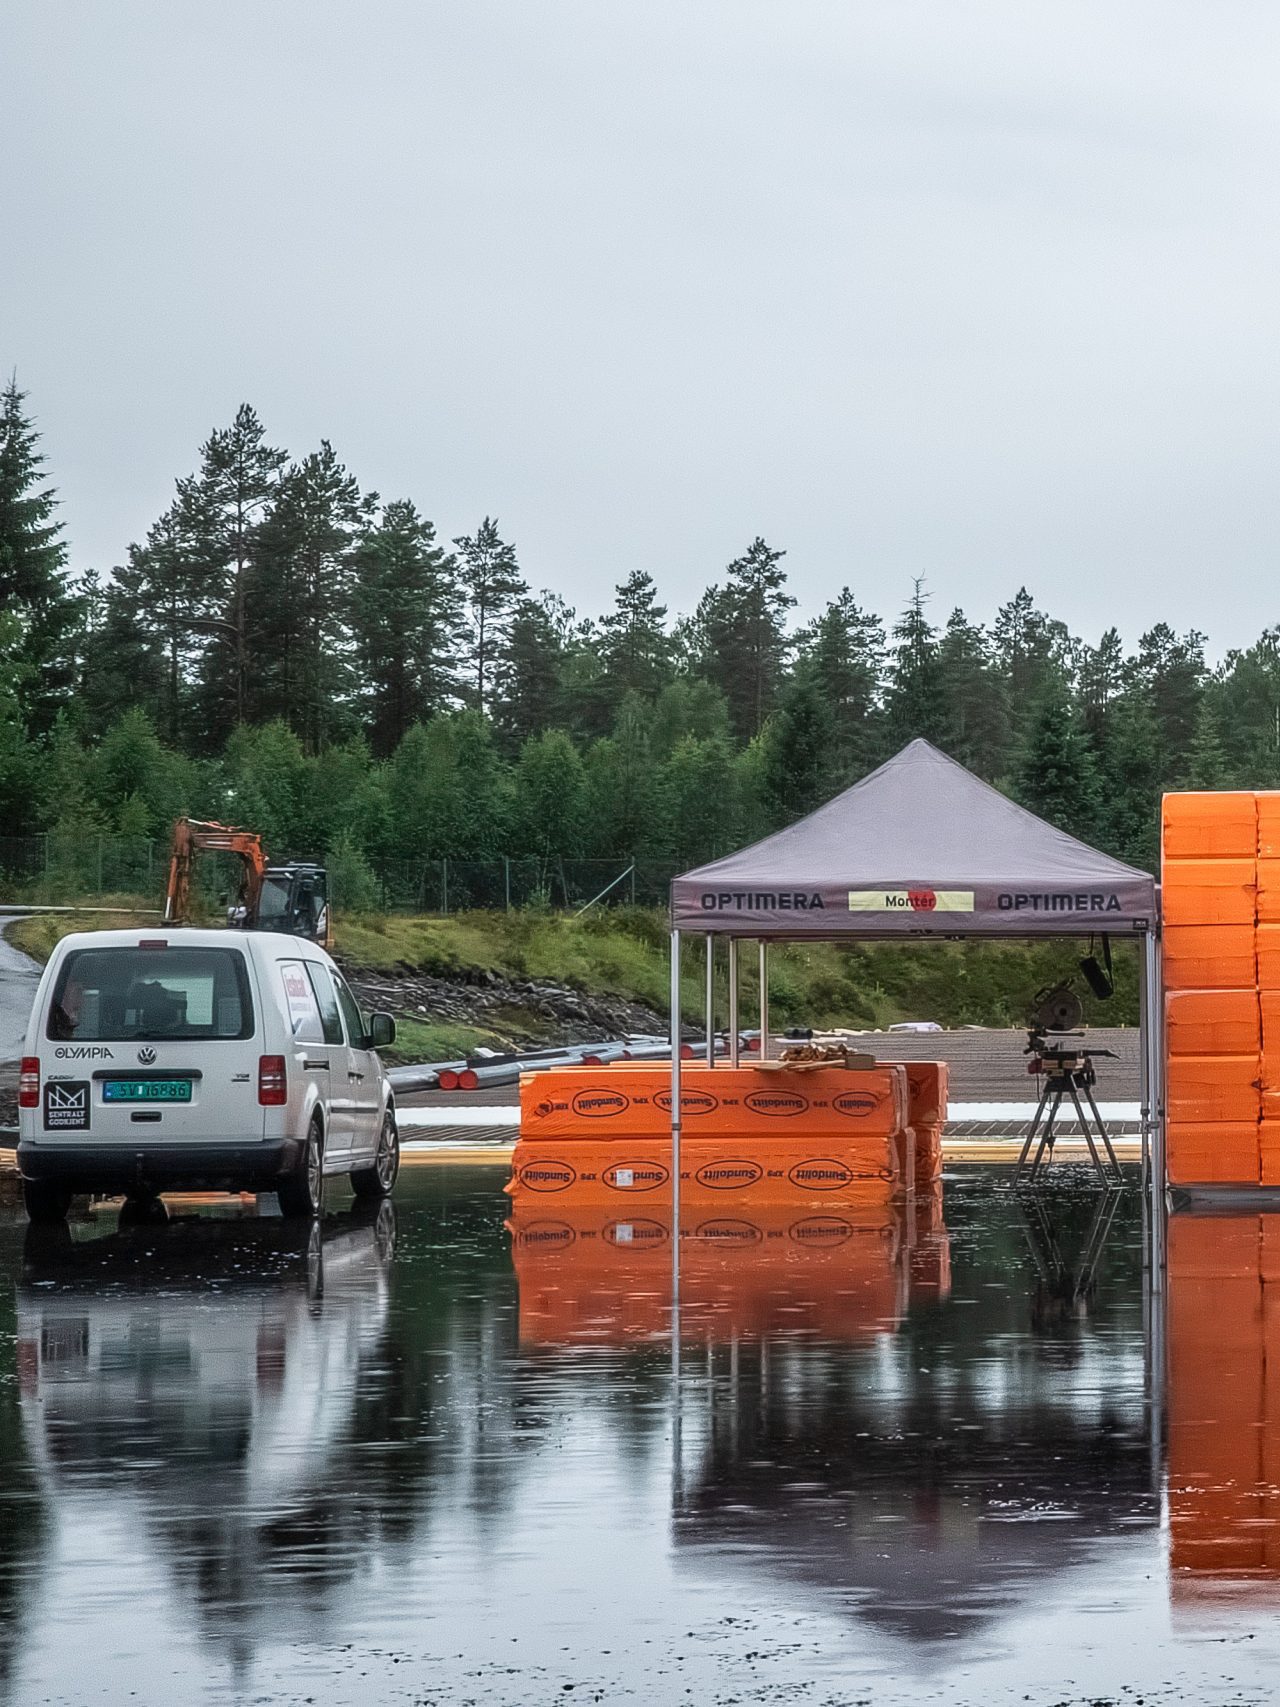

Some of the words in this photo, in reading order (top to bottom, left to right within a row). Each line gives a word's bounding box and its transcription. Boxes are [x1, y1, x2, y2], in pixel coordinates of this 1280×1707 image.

[701, 893, 825, 910] OPTIMERA
[885, 895, 934, 907] Montér
[998, 893, 1121, 911] OPTIMERA
[55, 1047, 114, 1059] OLYMPIA
[578, 1097, 625, 1110] Sundolitt
[752, 1098, 804, 1108] Sundolitt
[524, 1171, 571, 1182] Sundolitt
[703, 1169, 758, 1180] Sundolitt
[796, 1169, 848, 1181] Sundolitt
